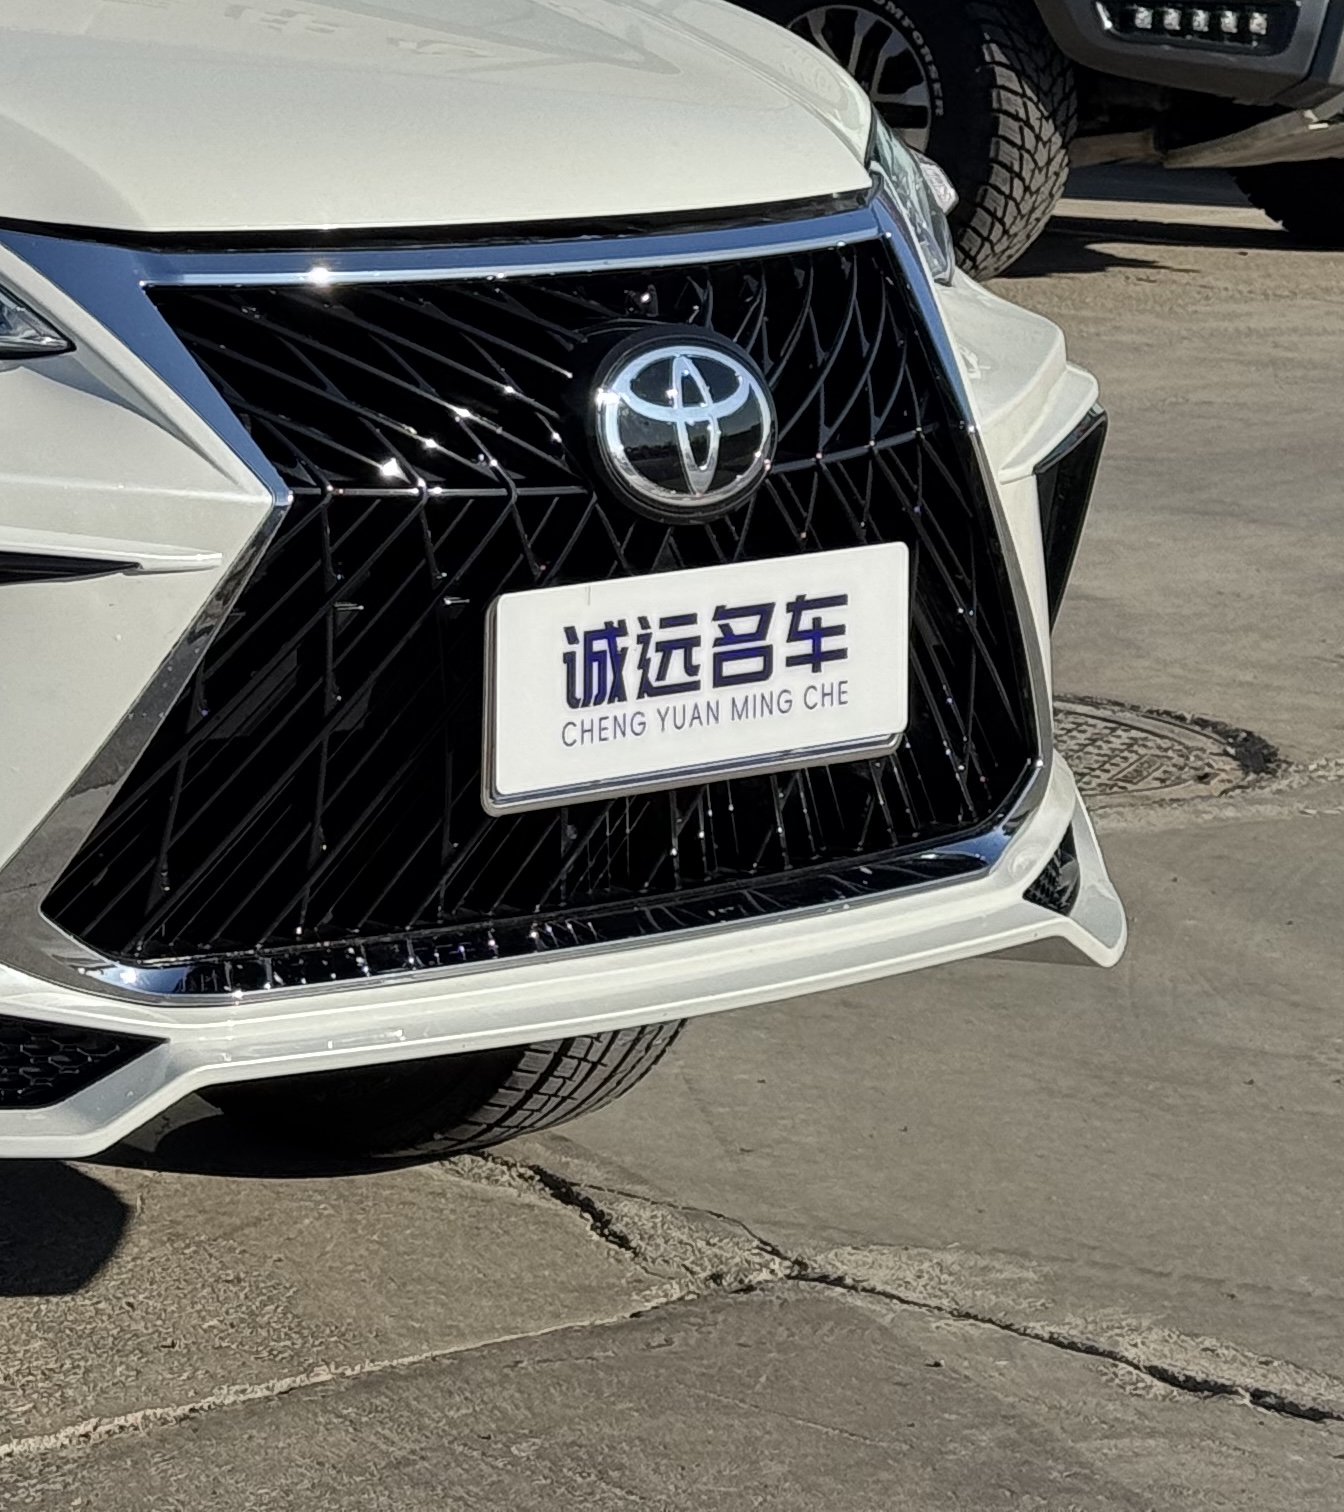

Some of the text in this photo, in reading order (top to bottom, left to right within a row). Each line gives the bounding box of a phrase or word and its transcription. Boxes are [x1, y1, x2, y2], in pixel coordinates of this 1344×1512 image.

[562, 593, 849, 708] 诚远名车
[561, 680, 849, 748] CHENG YUAN MING CHE
